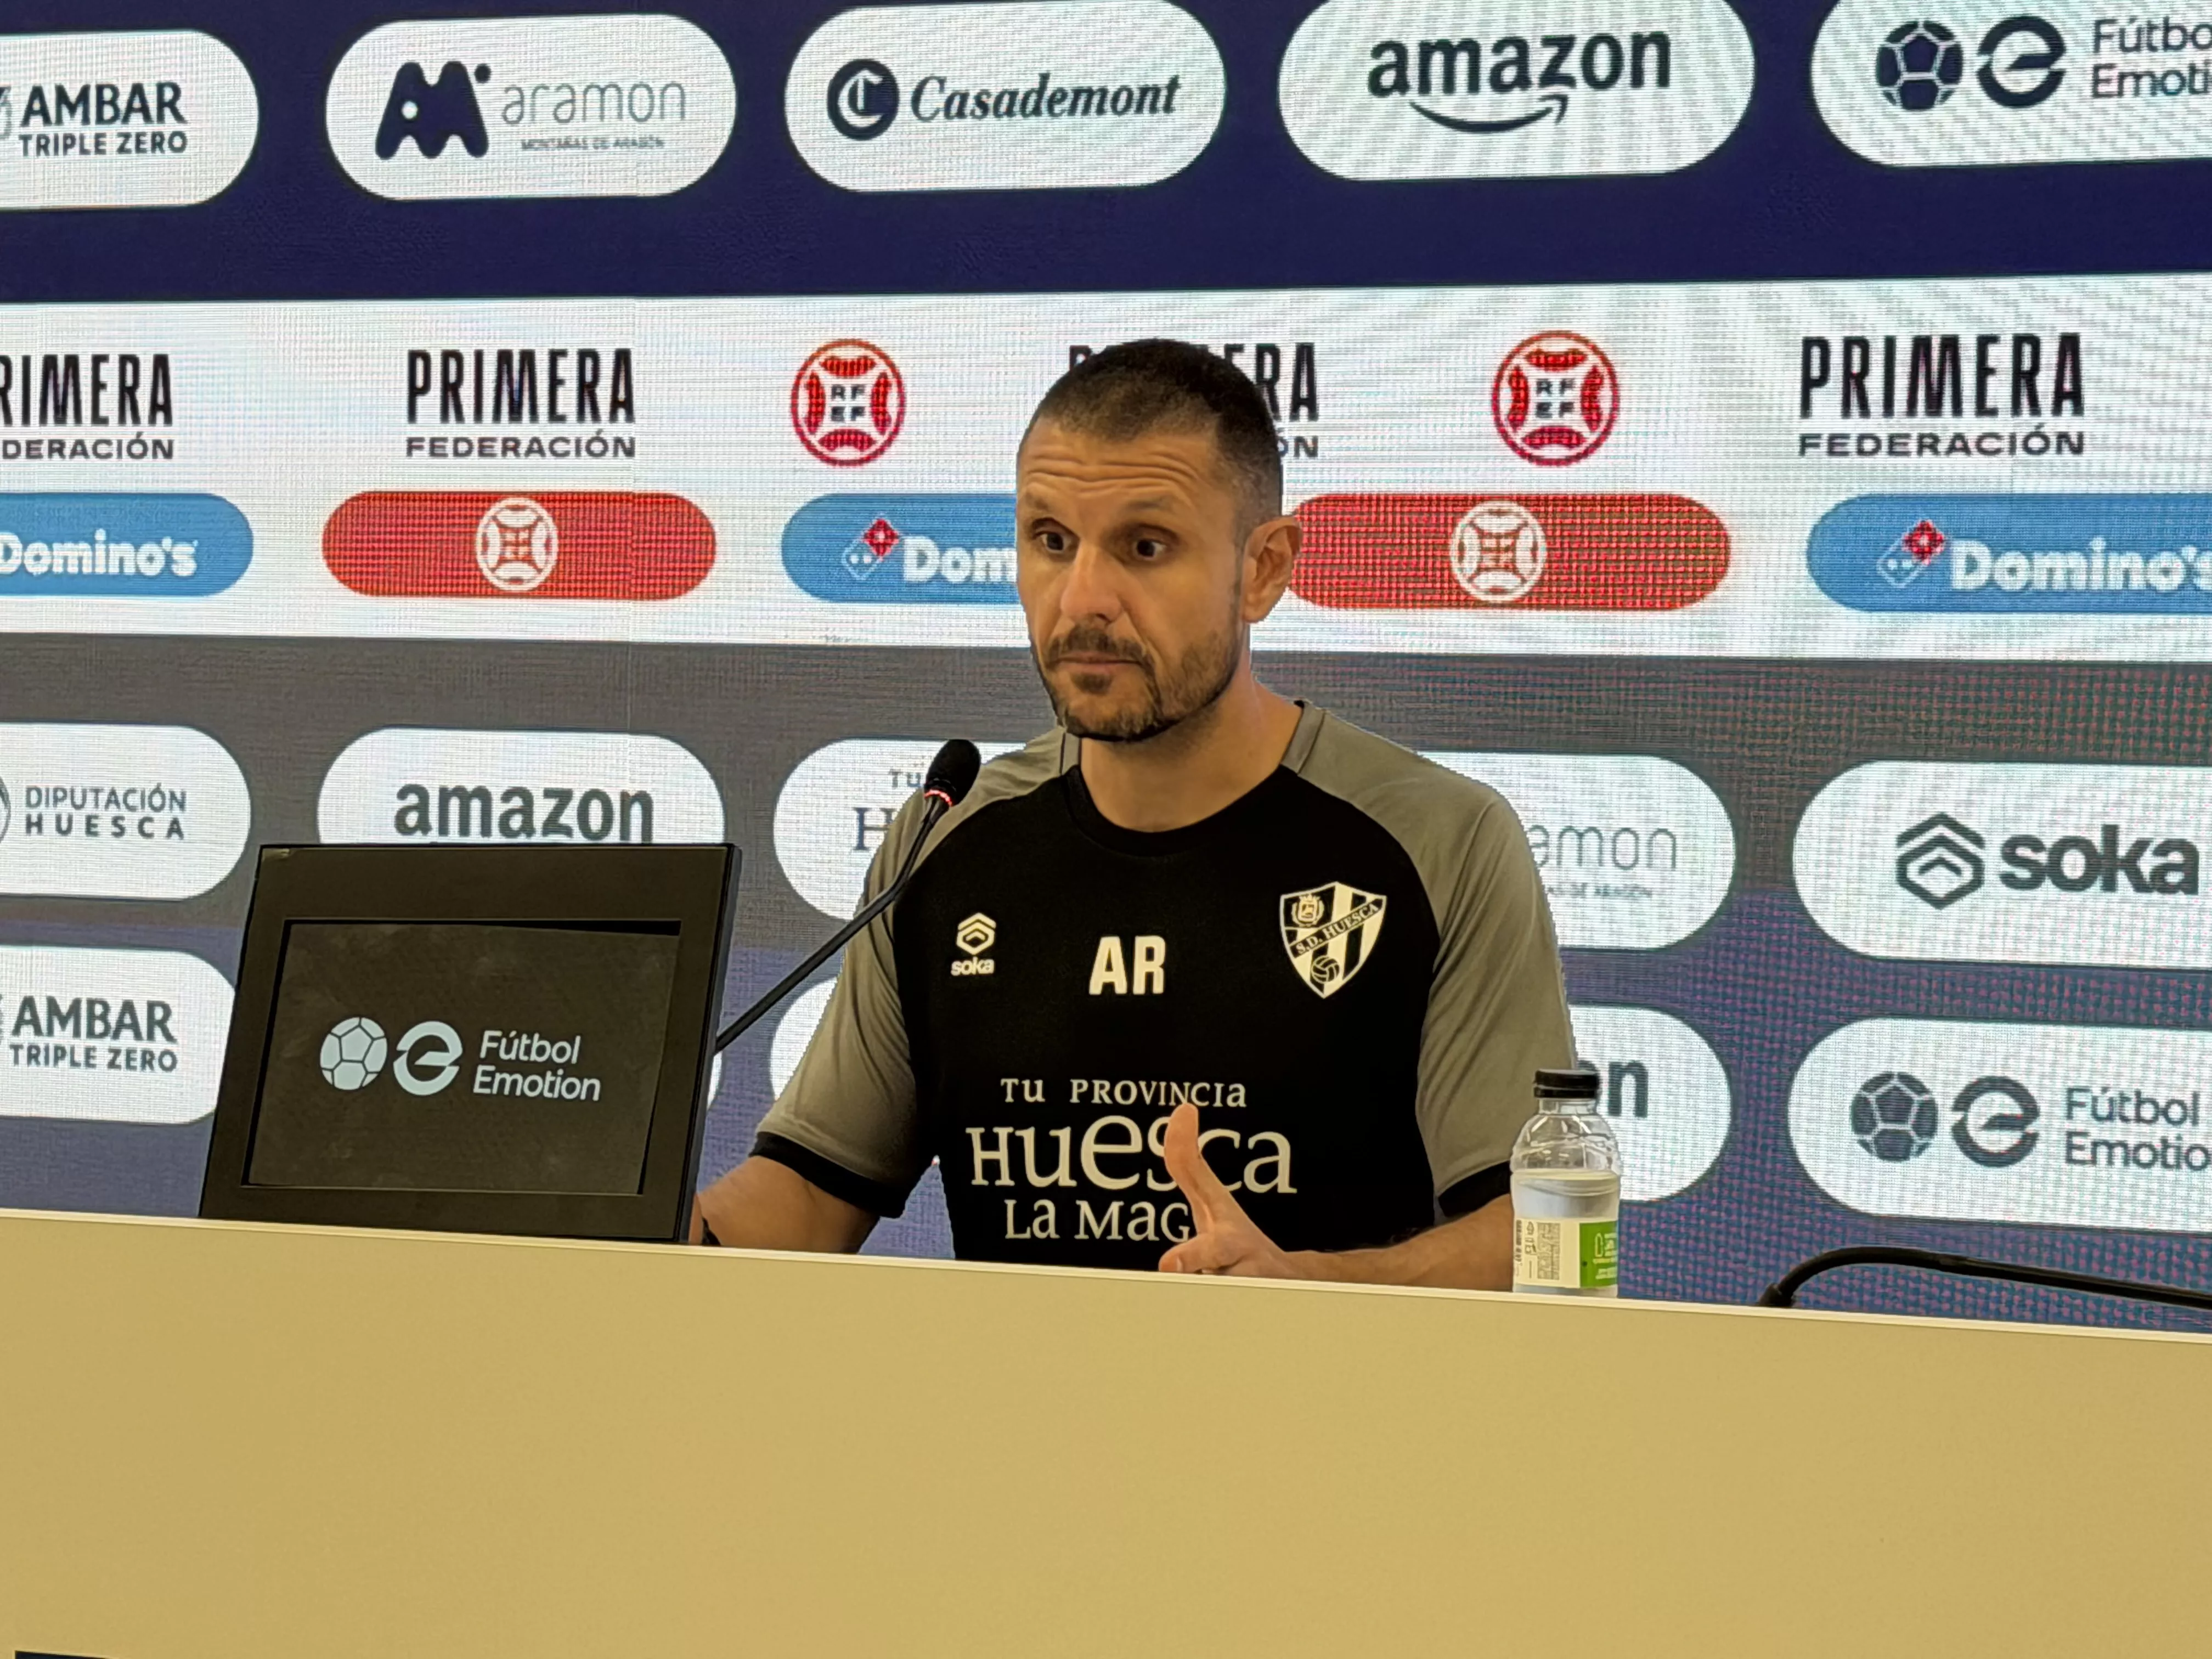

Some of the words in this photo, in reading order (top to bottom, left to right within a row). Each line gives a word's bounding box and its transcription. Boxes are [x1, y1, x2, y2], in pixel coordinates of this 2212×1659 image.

[1368, 31, 1671, 97] amazon
[20, 81, 188, 127] AMBAR
[502, 82, 686, 124] aramon
[911, 72, 1181, 123] Casademont
[19, 132, 106, 157] TRIPLE
[116, 129, 188, 155] ZERO
[407, 348, 636, 424] PRIMERA
[1800, 333, 2084, 420] PRIMERA
[405, 429, 636, 459] FEDERACIÓN
[1798, 422, 2084, 457] FEDERACIÓN
[0, 528, 198, 577] Domino's
[25, 783, 187, 812] DIPUTACIÓN
[393, 783, 654, 844] amazon
[25, 812, 184, 840] HUESCA
[1527, 825, 1676, 871] amon
[1999, 825, 2200, 895] soka
[1296, 934, 1322, 955] S.D.
[1323, 902, 1379, 939] HUESCA
[951, 956, 995, 976] soka
[1088, 935, 1166, 995] AR
[11, 995, 178, 1044] AMBAR
[9, 1043, 97, 1068] TRIPLE
[107, 1048, 178, 1073] ZERO
[480, 1030, 581, 1064] Fútbol
[473, 1065, 600, 1101] Emotion
[2066, 1087, 2200, 1126] Fútbol
